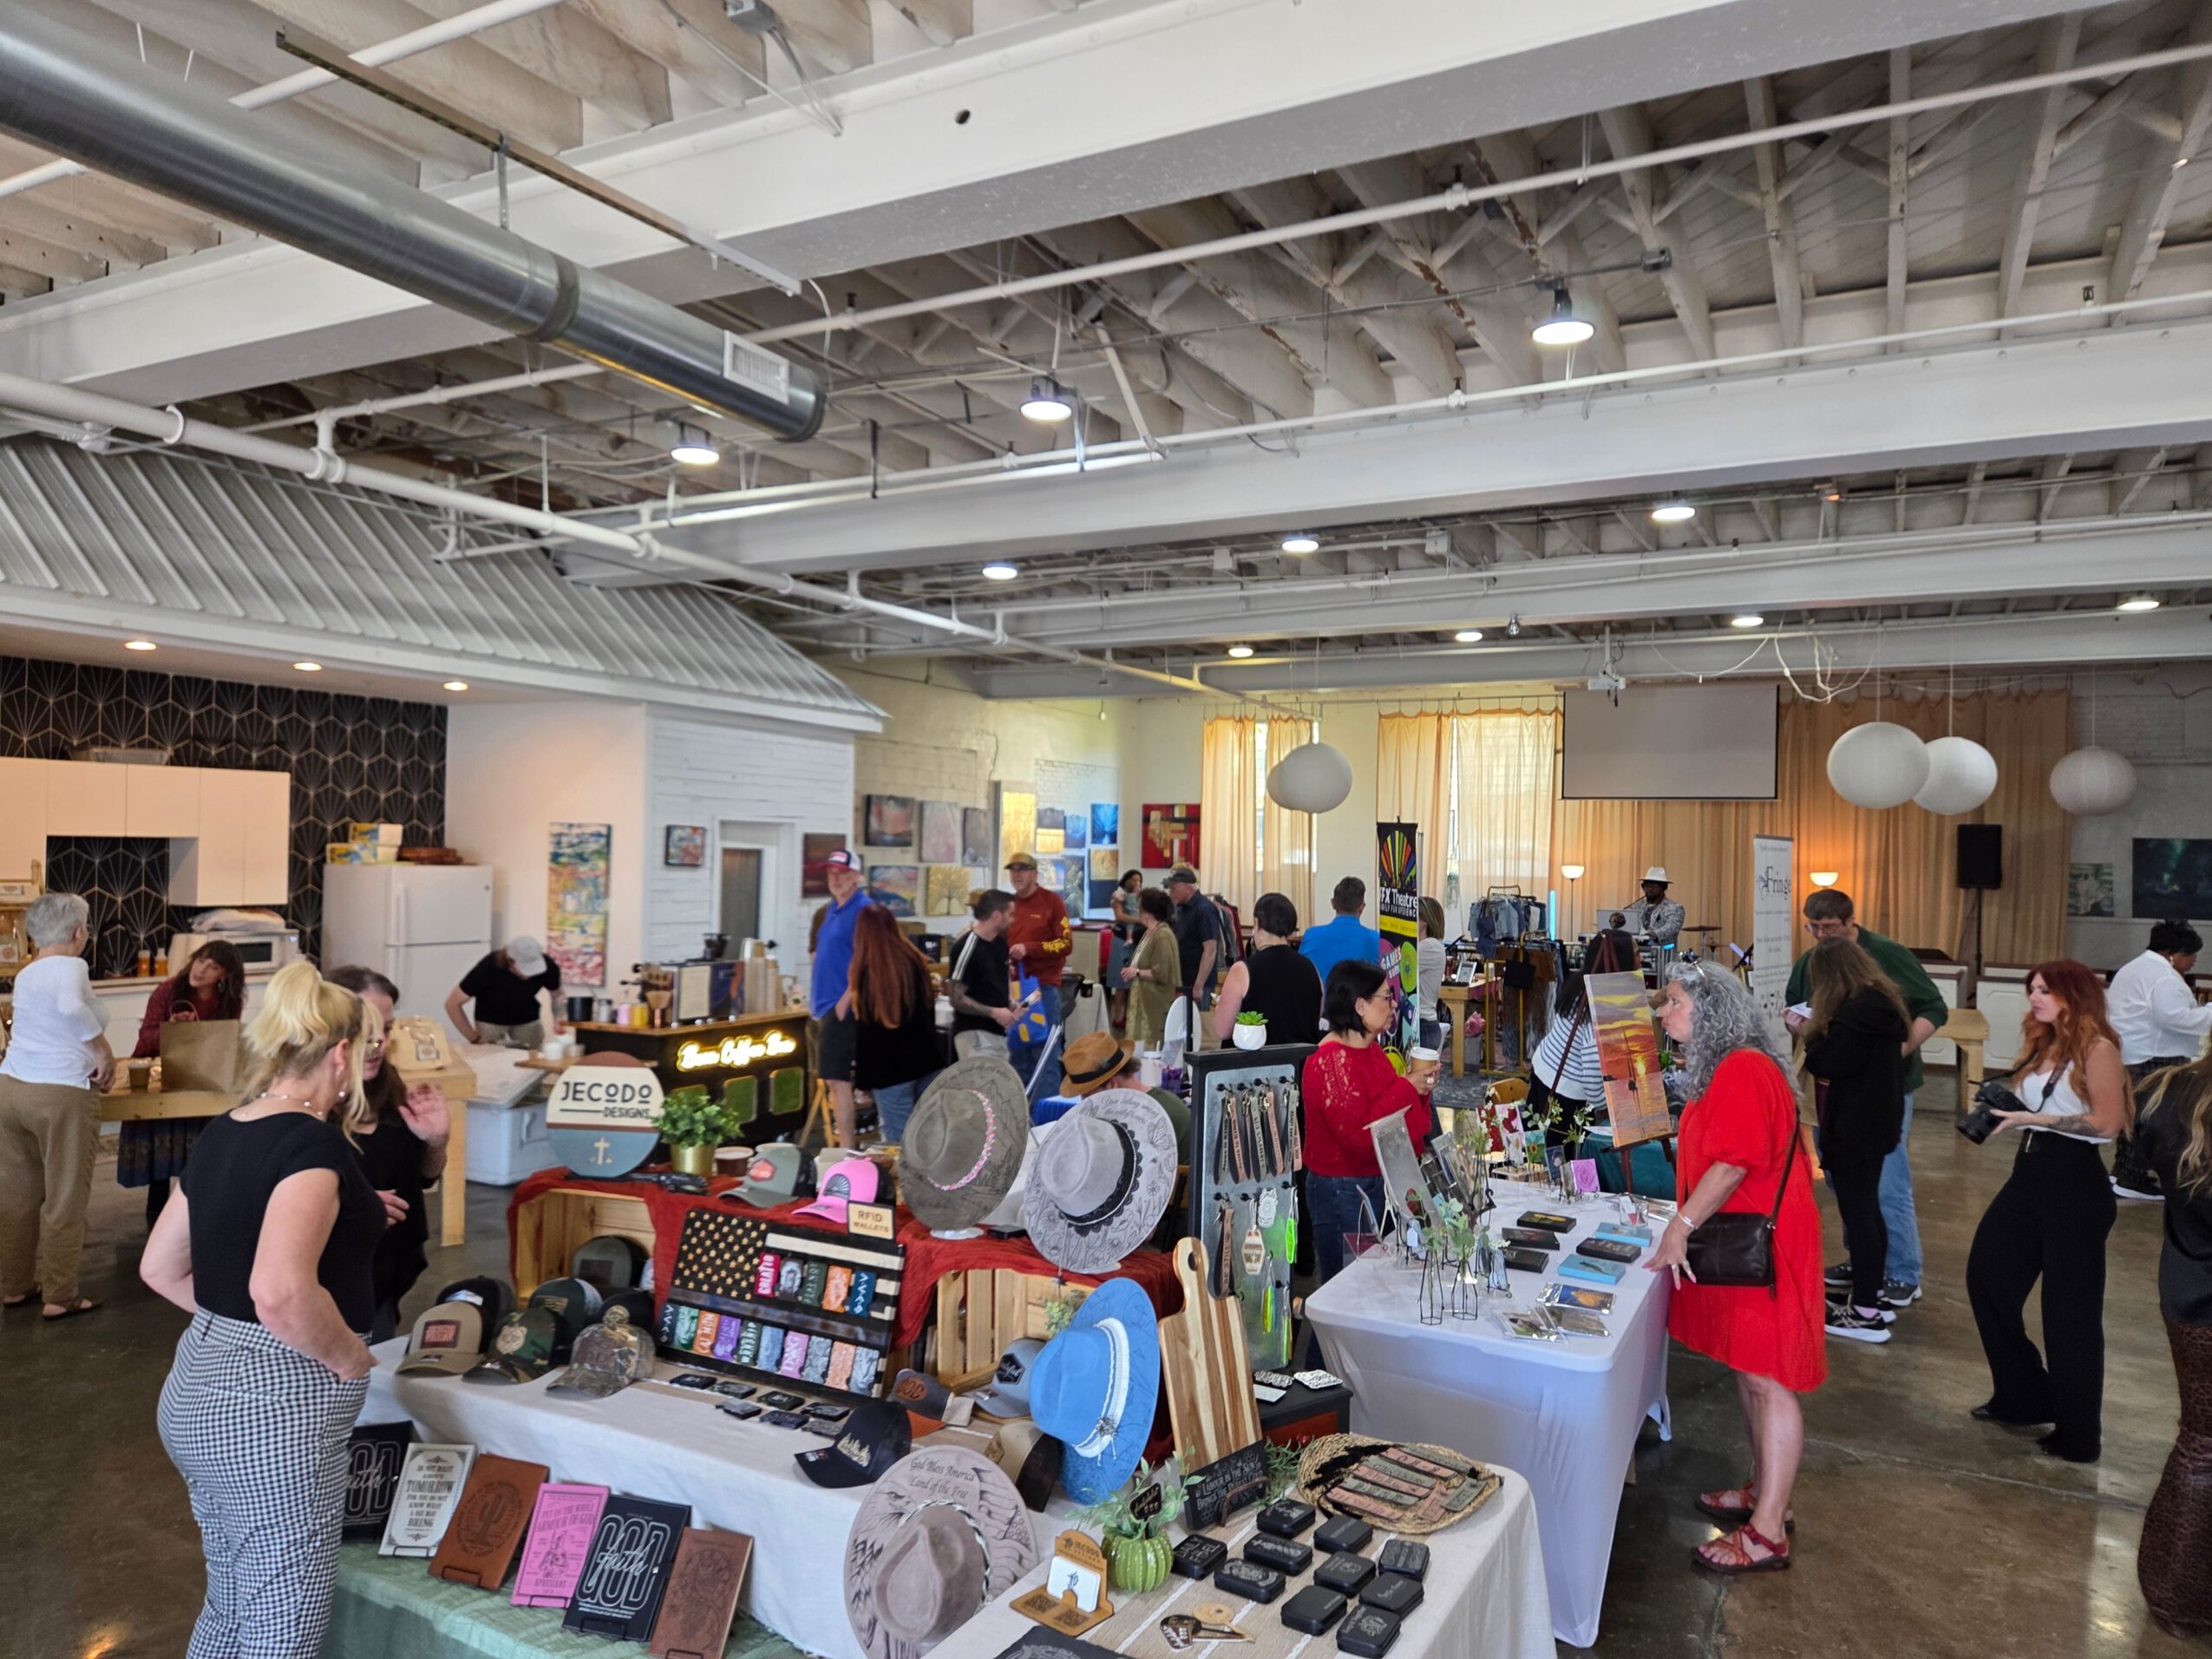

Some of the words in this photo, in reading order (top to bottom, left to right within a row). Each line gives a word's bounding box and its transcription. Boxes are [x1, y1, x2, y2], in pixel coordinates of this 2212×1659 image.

[1766, 865, 1791, 901] Fringe
[1391, 888, 1418, 909] Theatre
[721, 1038, 767, 1067] Coffee
[560, 1081, 652, 1104] JECODO
[603, 1107, 651, 1120] DESIGNS
[853, 1222, 889, 1233] WALLETS
[858, 1211, 883, 1223] RFID
[344, 1441, 401, 1518] OD
[910, 1457, 930, 1472] God
[926, 1460, 946, 1474] Bless
[946, 1466, 976, 1482] America
[406, 1479, 455, 1492] TOMORROW
[909, 1476, 934, 1489] Land
[929, 1479, 943, 1497] of
[938, 1480, 952, 1494] the
[952, 1486, 969, 1499] Free
[408, 1518, 434, 1527] BRING
[576, 1514, 671, 1610] GOD
[587, 1532, 656, 1587] faith
